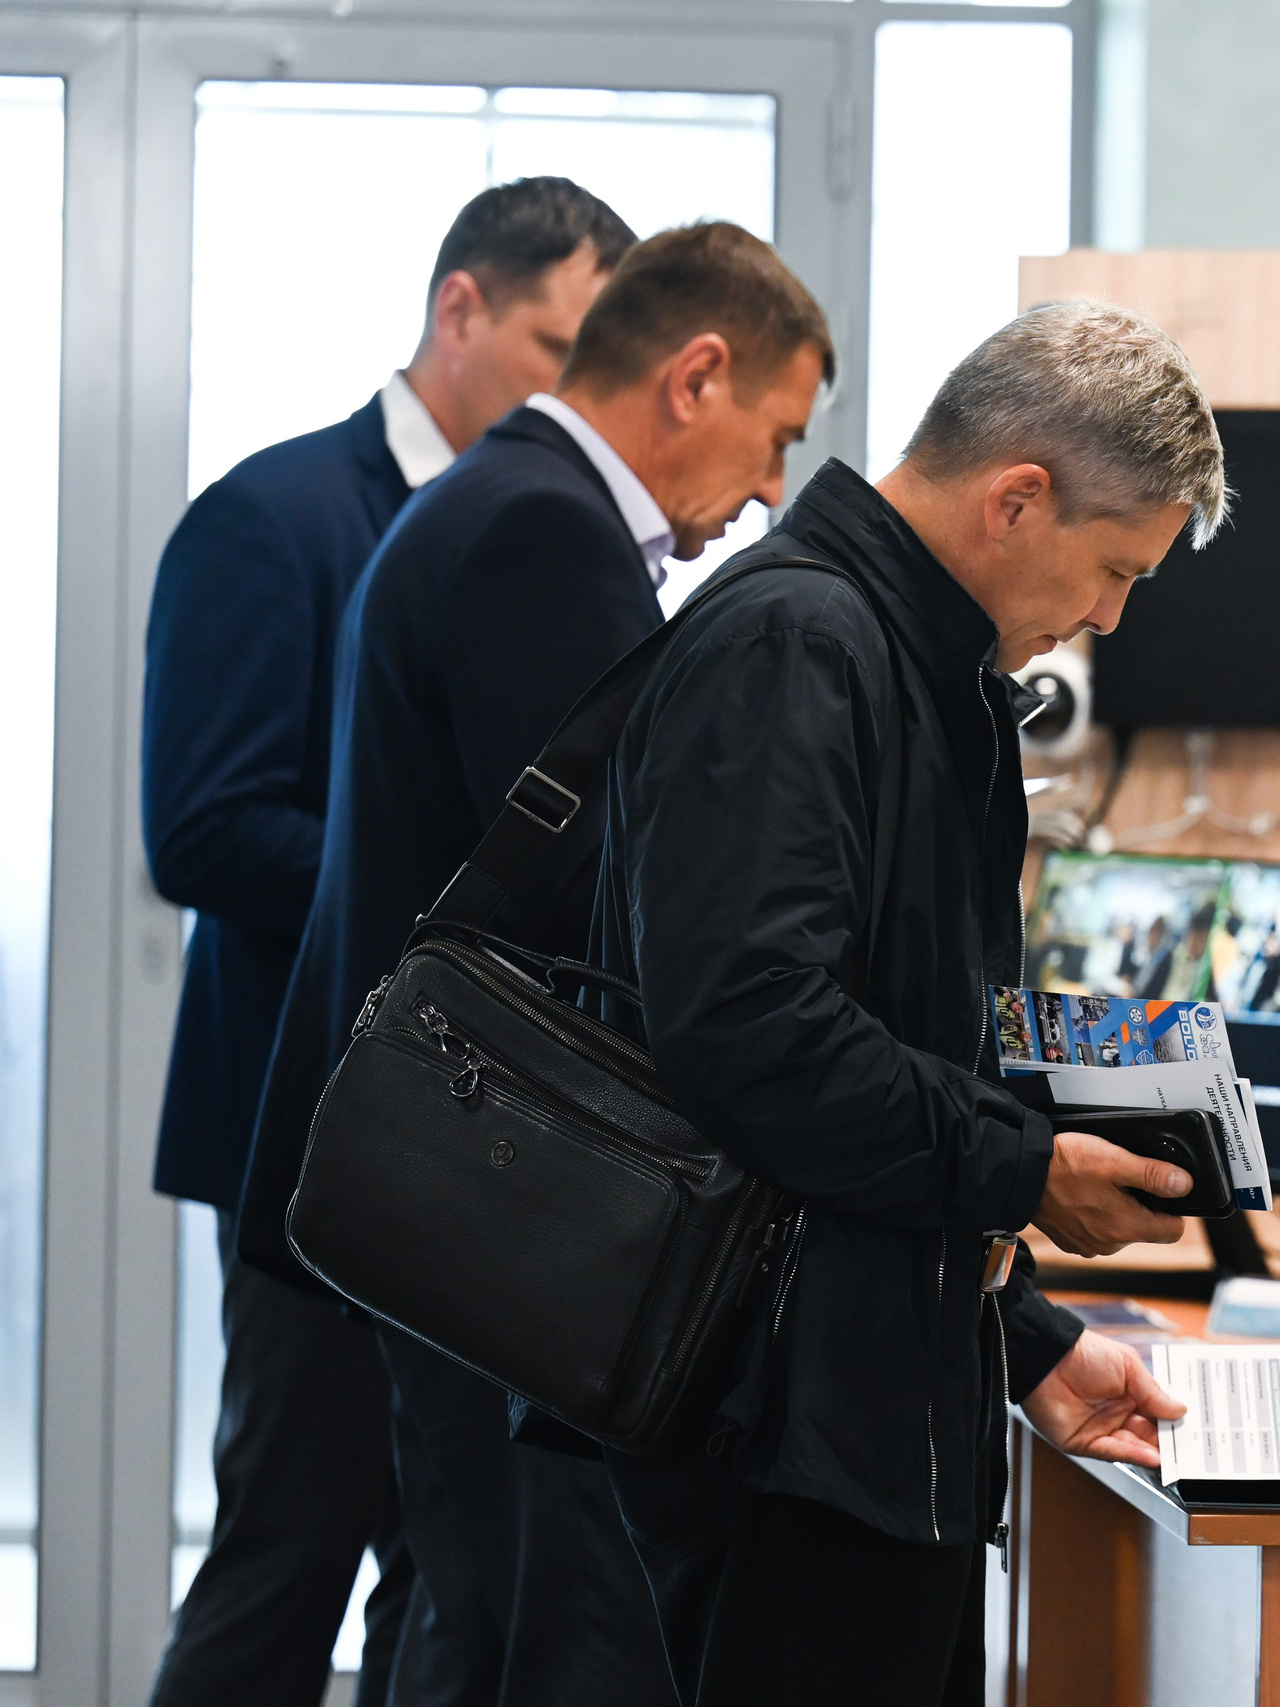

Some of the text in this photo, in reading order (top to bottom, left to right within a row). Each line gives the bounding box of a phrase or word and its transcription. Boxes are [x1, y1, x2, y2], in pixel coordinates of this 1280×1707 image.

[1156, 1087, 1168, 1109] НАУКА
[1214, 1073, 1253, 1172] НАШИ НАПРАВЛЕНИЯ
